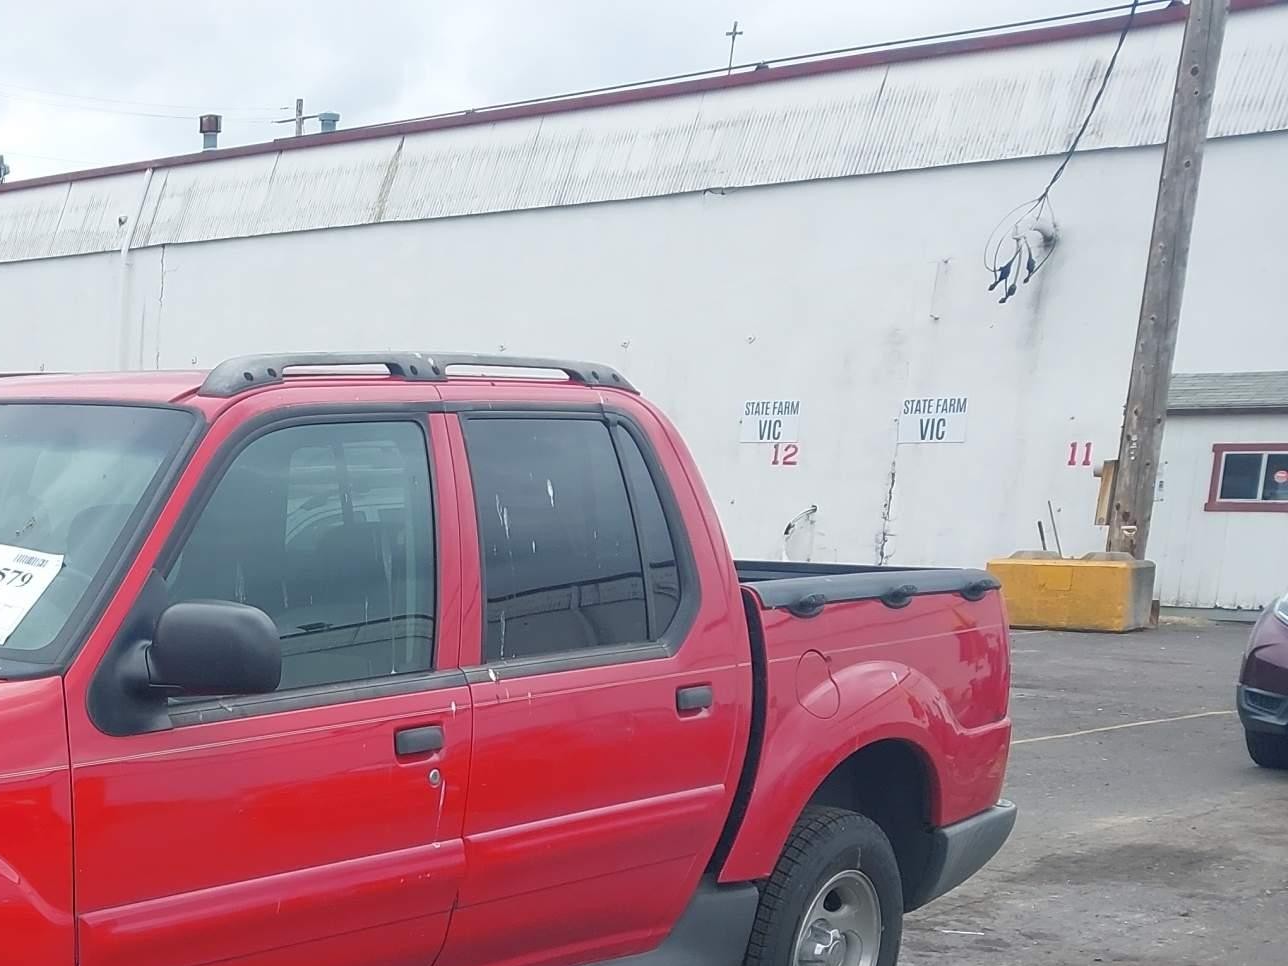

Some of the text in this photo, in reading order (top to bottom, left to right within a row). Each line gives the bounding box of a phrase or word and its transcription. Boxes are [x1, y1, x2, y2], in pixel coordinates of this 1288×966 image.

[744, 400, 800, 416] STATE FARM
[903, 398, 967, 415] STATE FARM
[758, 419, 782, 441] VIC
[919, 418, 946, 441] VIC
[771, 444, 799, 465] 12
[1067, 442, 1092, 466] 11
